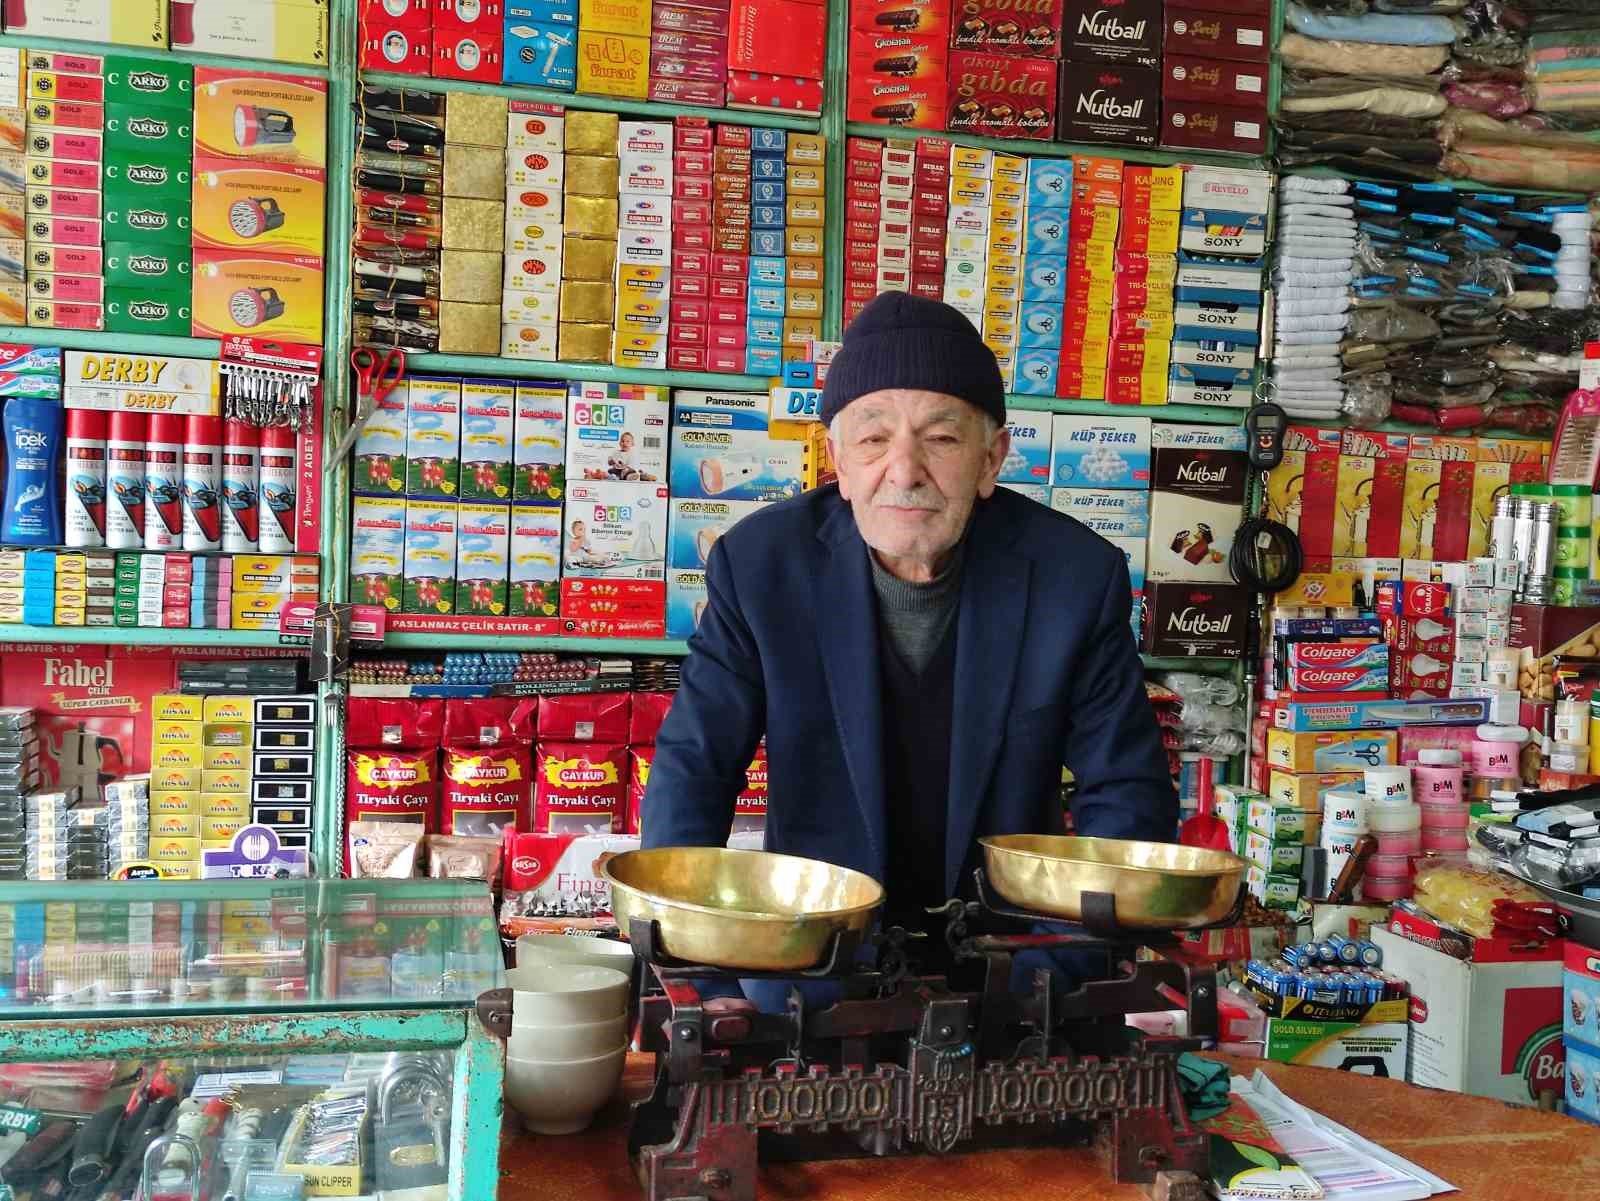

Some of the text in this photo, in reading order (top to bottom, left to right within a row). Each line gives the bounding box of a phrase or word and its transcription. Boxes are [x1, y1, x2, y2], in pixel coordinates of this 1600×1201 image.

[1078, 10, 1148, 41] Nutball
[107, 73, 190, 92] C ARKO C
[59, 105, 82, 114] GOLD
[1076, 89, 1144, 120] Nutball
[107, 119, 190, 138] C ARKO C
[106, 166, 189, 183] C ARKO C
[57, 193, 79, 203] GOLD
[131, 214, 165, 226] ARKO
[64, 223, 86, 233] GOLD
[1203, 236, 1244, 248] SONY
[65, 253, 87, 262] GOLD
[131, 260, 165, 272] ARKO
[58, 278, 81, 287] GOLD
[131, 304, 166, 317] ARKO
[1197, 313, 1238, 325] SONY
[1196, 352, 1236, 364] SONY
[81, 355, 168, 385] DERBY
[124, 392, 178, 410] DERBY
[705, 395, 757, 409] Panasonic
[1193, 390, 1233, 403] SONY
[575, 404, 625, 427] eda
[15, 430, 49, 449] ipek
[680, 432, 733, 444] GOLD SILVER
[1006, 427, 1037, 440] EKER
[1070, 429, 1137, 446] KÜP ŞEKER
[1174, 433, 1226, 446] KÜP ŞEKER
[304, 436, 315, 469] ADET
[305, 471, 314, 480] 2
[1176, 460, 1228, 484] Nutball
[678, 503, 731, 514] GOLD SILVER
[1073, 496, 1125, 509] KÜP ŞEKER
[595, 505, 632, 522] eda
[1095, 521, 1125, 532] ŞEKER
[676, 574, 699, 585] GOLD
[392, 620, 461, 632] PASLANMAZ
[461, 620, 495, 632] ÇELİK
[1166, 606, 1233, 636] Nutball
[172, 647, 241, 658] PASLANMAZ
[1301, 646, 1356, 660] Colgate
[43, 658, 114, 687] Fabel
[1301, 670, 1356, 683] Colgate
[87, 686, 111, 697] ÇELİK
[514, 682, 559, 690] ROLLING
[1488, 753, 1509, 767] B&M
[560, 769, 605, 781] ÇAYKUR
[1386, 782, 1406, 796] B&M
[1432, 779, 1453, 792] B&M
[356, 793, 429, 808] Tiryaki Çayı
[450, 792, 520, 805] Tiryaki Çayı
[546, 793, 617, 808] Tiryaki Çayı
[736, 796, 769, 808] iryaki
[1335, 808, 1356, 821] B&M
[556, 872, 613, 897] Fing
[1273, 1024, 1323, 1036] GOLD SILVER
[320, 1175, 353, 1188] CLIPPER
